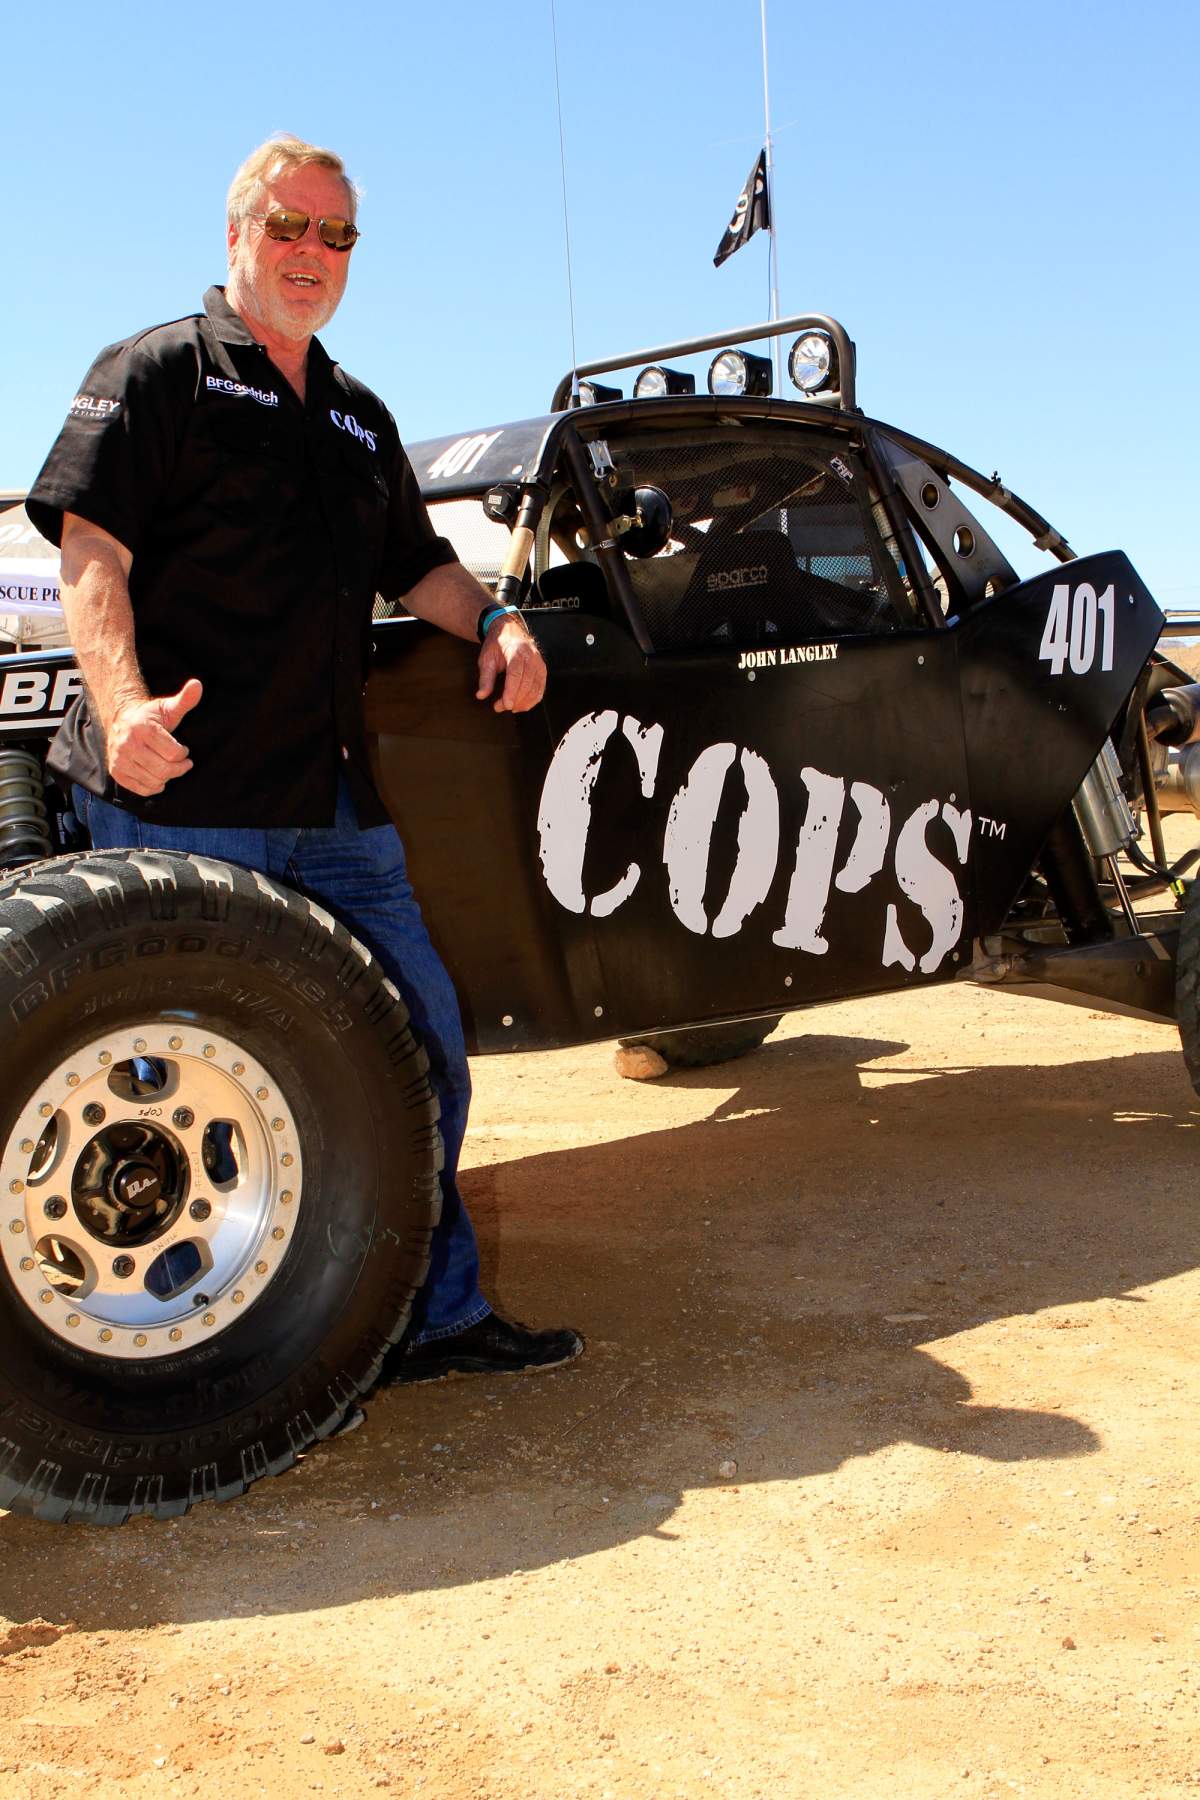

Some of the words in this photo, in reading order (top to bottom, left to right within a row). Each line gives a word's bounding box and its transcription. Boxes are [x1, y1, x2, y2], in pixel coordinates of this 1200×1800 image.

[206, 375, 279, 404] BFGoodrich
[330, 409, 375, 451] COPS
[427, 430, 505, 480] 401
[0, 585, 38, 600] SCUE
[1038, 582, 1115, 675] 401
[738, 650, 776, 669] JOHN
[780, 644, 838, 665] LANGLEY
[0, 669, 84, 715] BF
[537, 710, 972, 973] COPS
[978, 816, 1006, 840] TM
